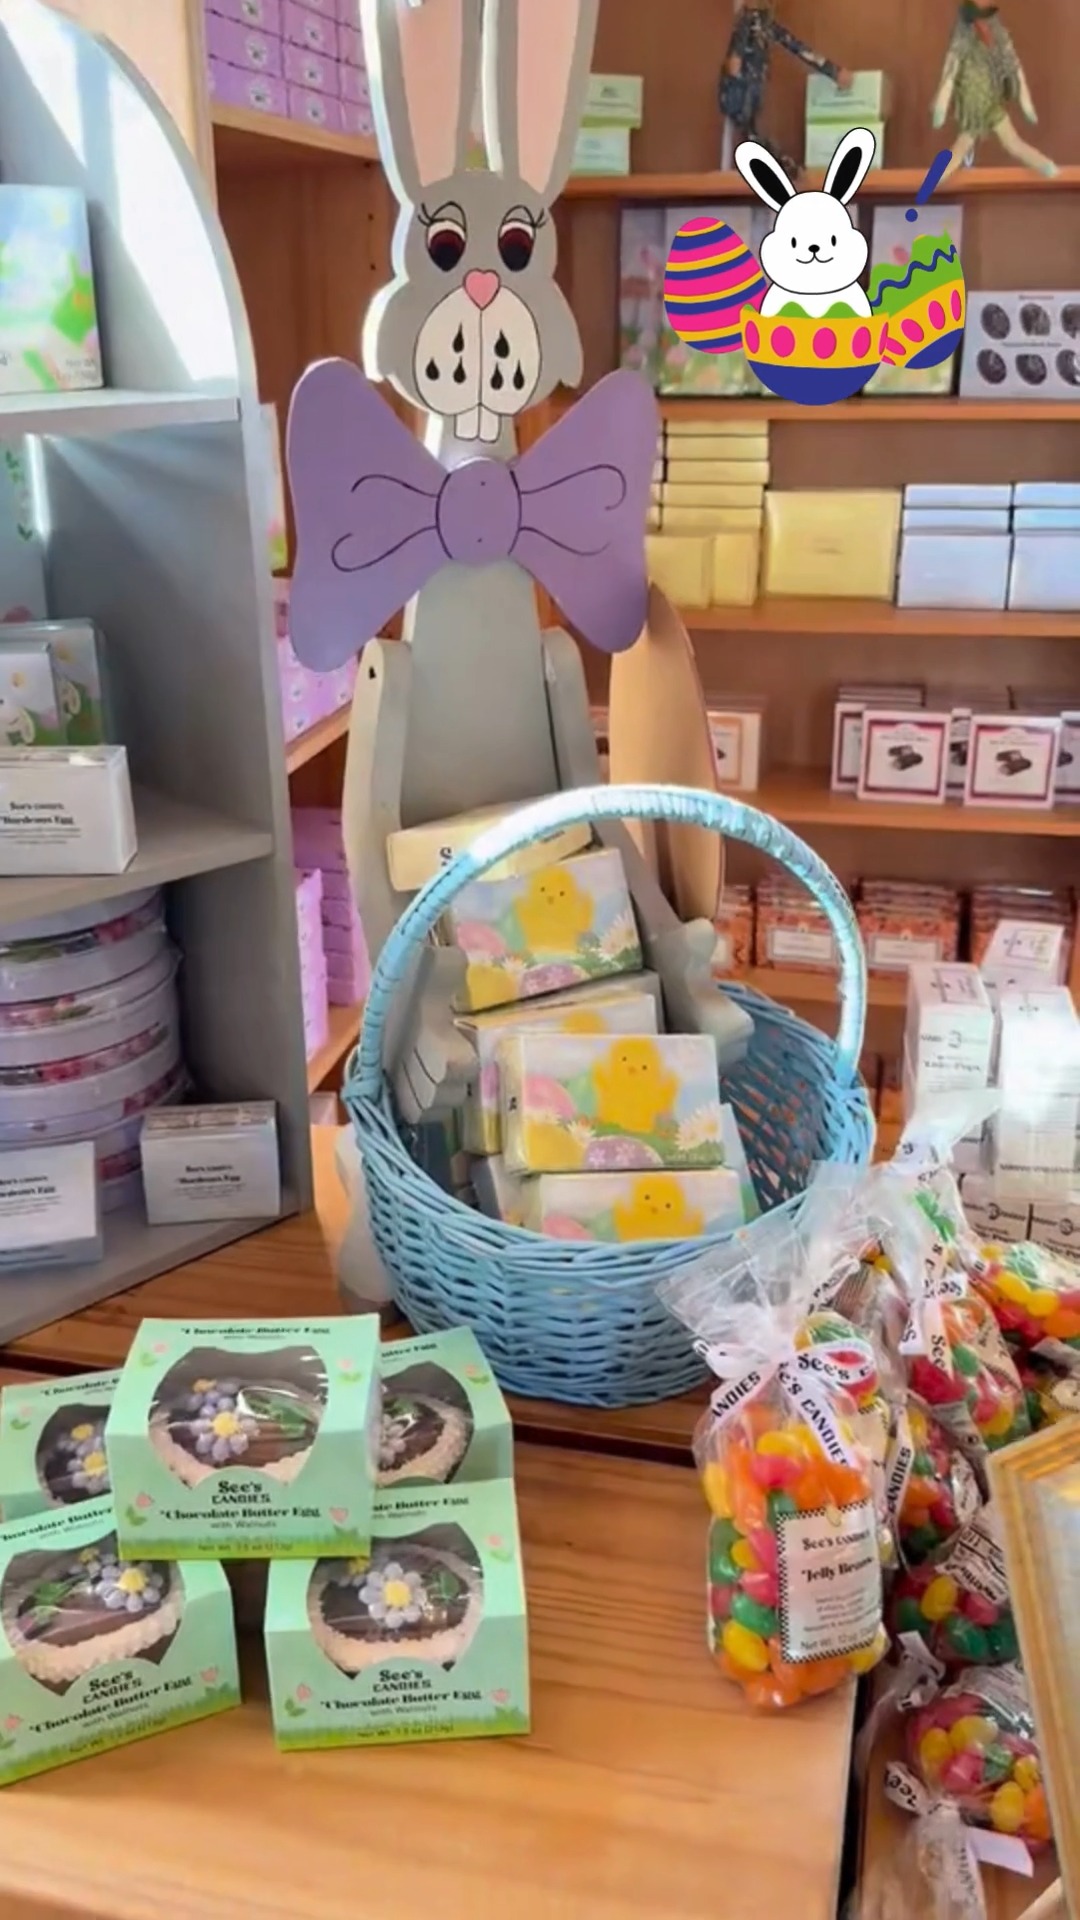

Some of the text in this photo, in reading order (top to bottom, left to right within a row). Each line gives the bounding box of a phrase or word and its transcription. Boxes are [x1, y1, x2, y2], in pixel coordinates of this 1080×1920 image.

[381, 1347, 412, 1358] utter
[798, 1353, 850, 1381] See's
[711, 1370, 762, 1418] ANDIES
[217, 1479, 263, 1494] See's
[211, 1493, 271, 1505] CANDIES
[241, 1507, 290, 1519] Butter
[292, 1506, 321, 1519] Egg
[802, 1535, 834, 1551] See's
[89, 1670, 134, 1693] See's
[379, 1668, 424, 1683] See's
[82, 1677, 143, 1705] CANDIES
[113, 1685, 162, 1709] Butter
[163, 1675, 193, 1692] Egg
[372, 1678, 432, 1694] CANDIES
[401, 1691, 451, 1704] Butter
[452, 1690, 482, 1700] Egg
